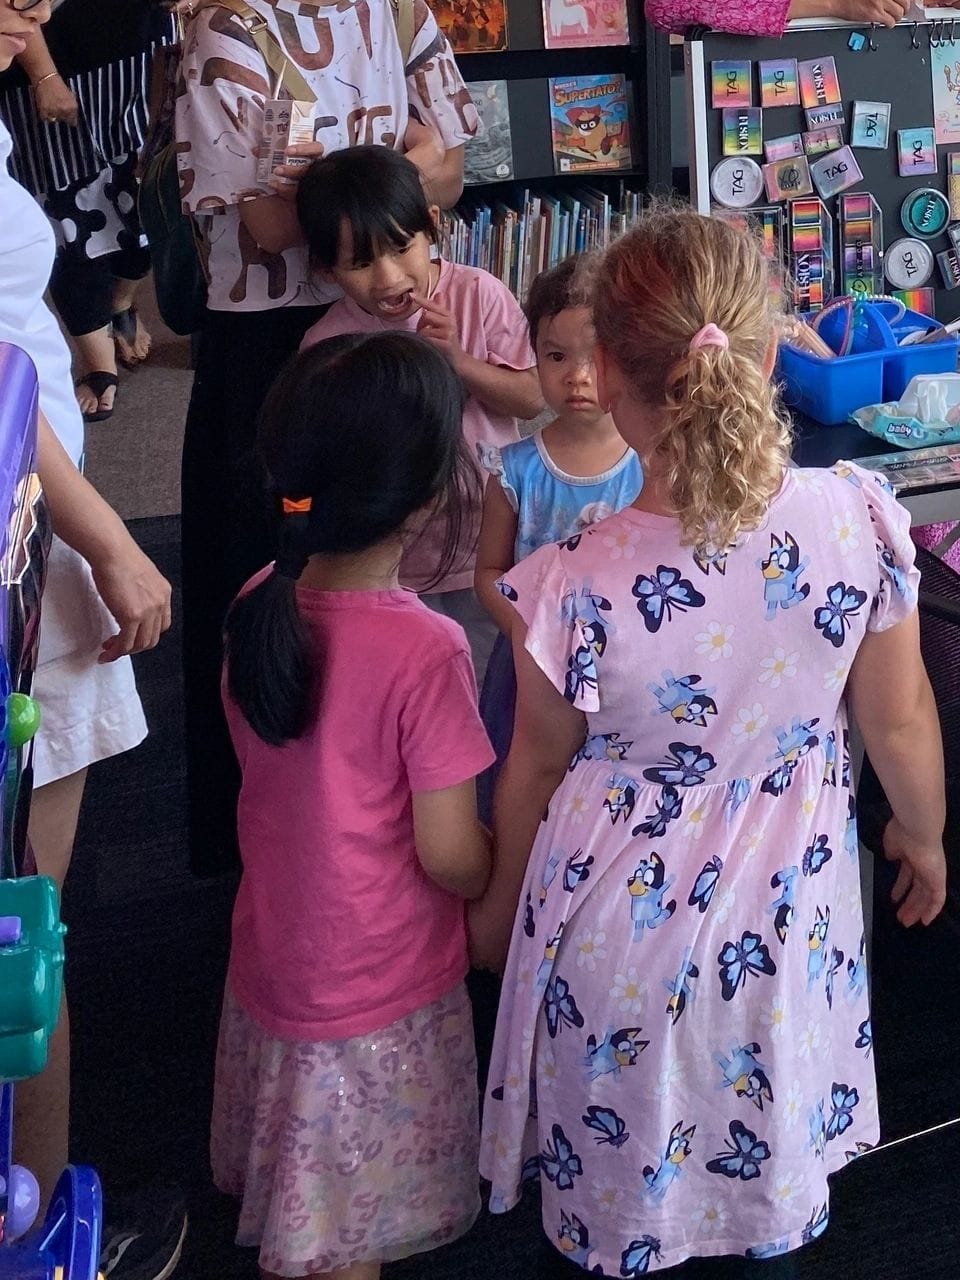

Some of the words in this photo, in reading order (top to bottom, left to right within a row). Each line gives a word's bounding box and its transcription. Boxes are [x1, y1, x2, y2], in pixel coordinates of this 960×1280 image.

[726, 70, 737, 97] TAG
[773, 70, 785, 97] TAG
[865, 112, 878, 138] TAG
[912, 140, 925, 166] TAG
[732, 169, 745, 196] TAG
[823, 161, 848, 180] TAG
[902, 251, 918, 279] TAG
[887, 423, 912, 437] baby
